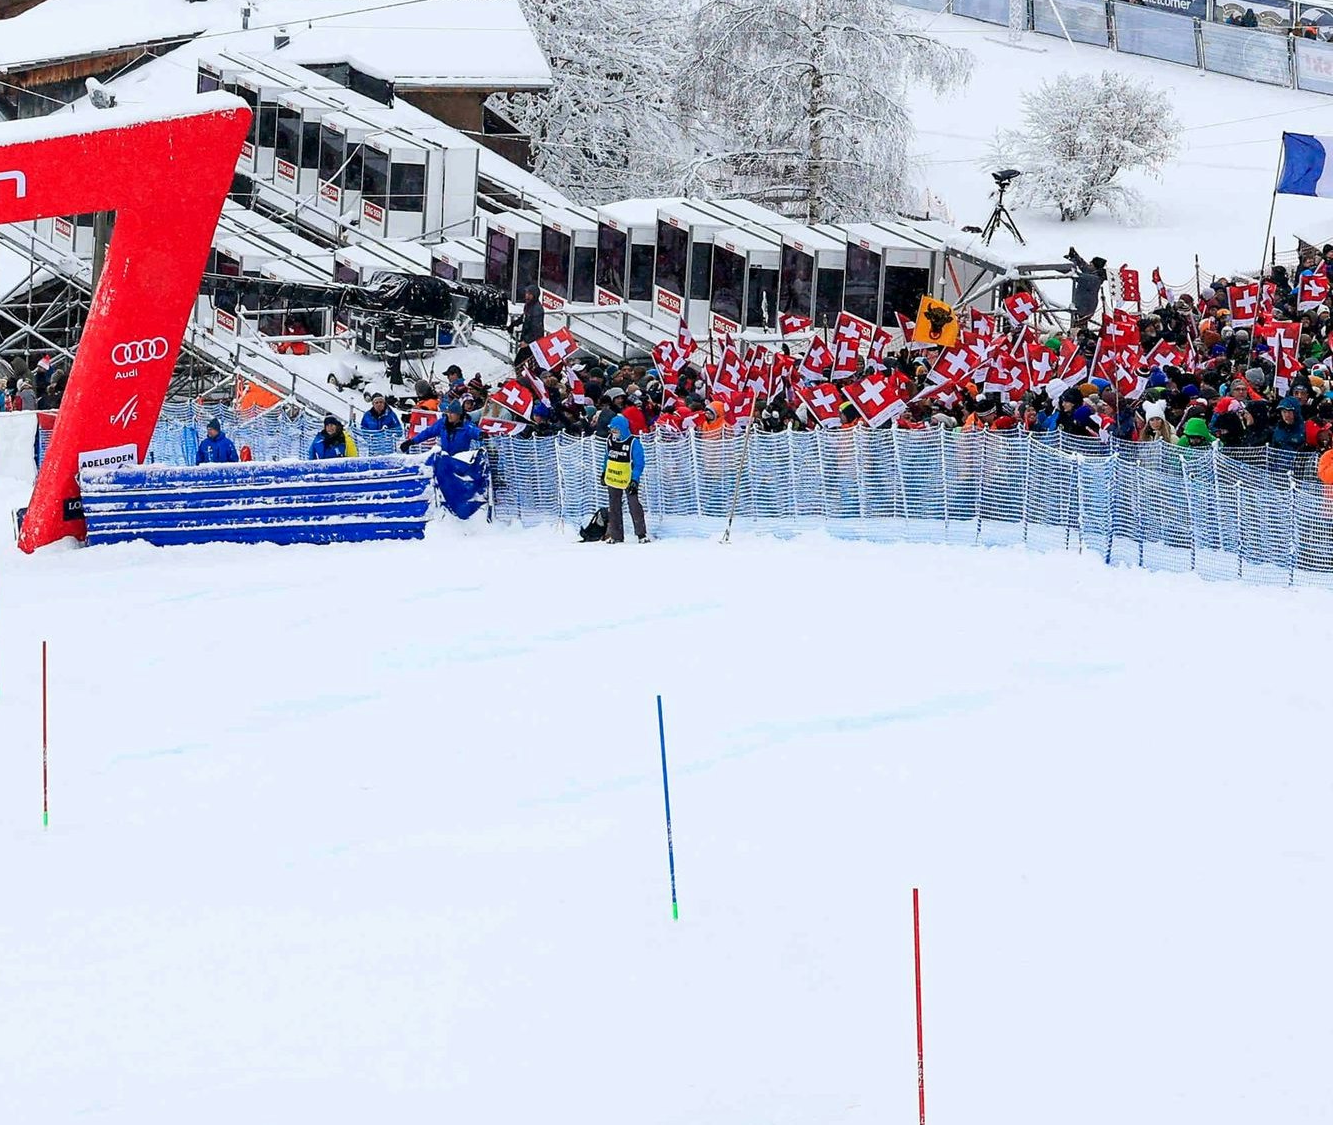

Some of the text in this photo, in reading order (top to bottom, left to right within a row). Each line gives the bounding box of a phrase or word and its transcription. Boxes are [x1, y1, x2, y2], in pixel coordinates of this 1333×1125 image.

[658, 293, 680, 308] SRG SSR
[115, 369, 138, 381] Audi
[81, 453, 134, 468] ADELBODEN
